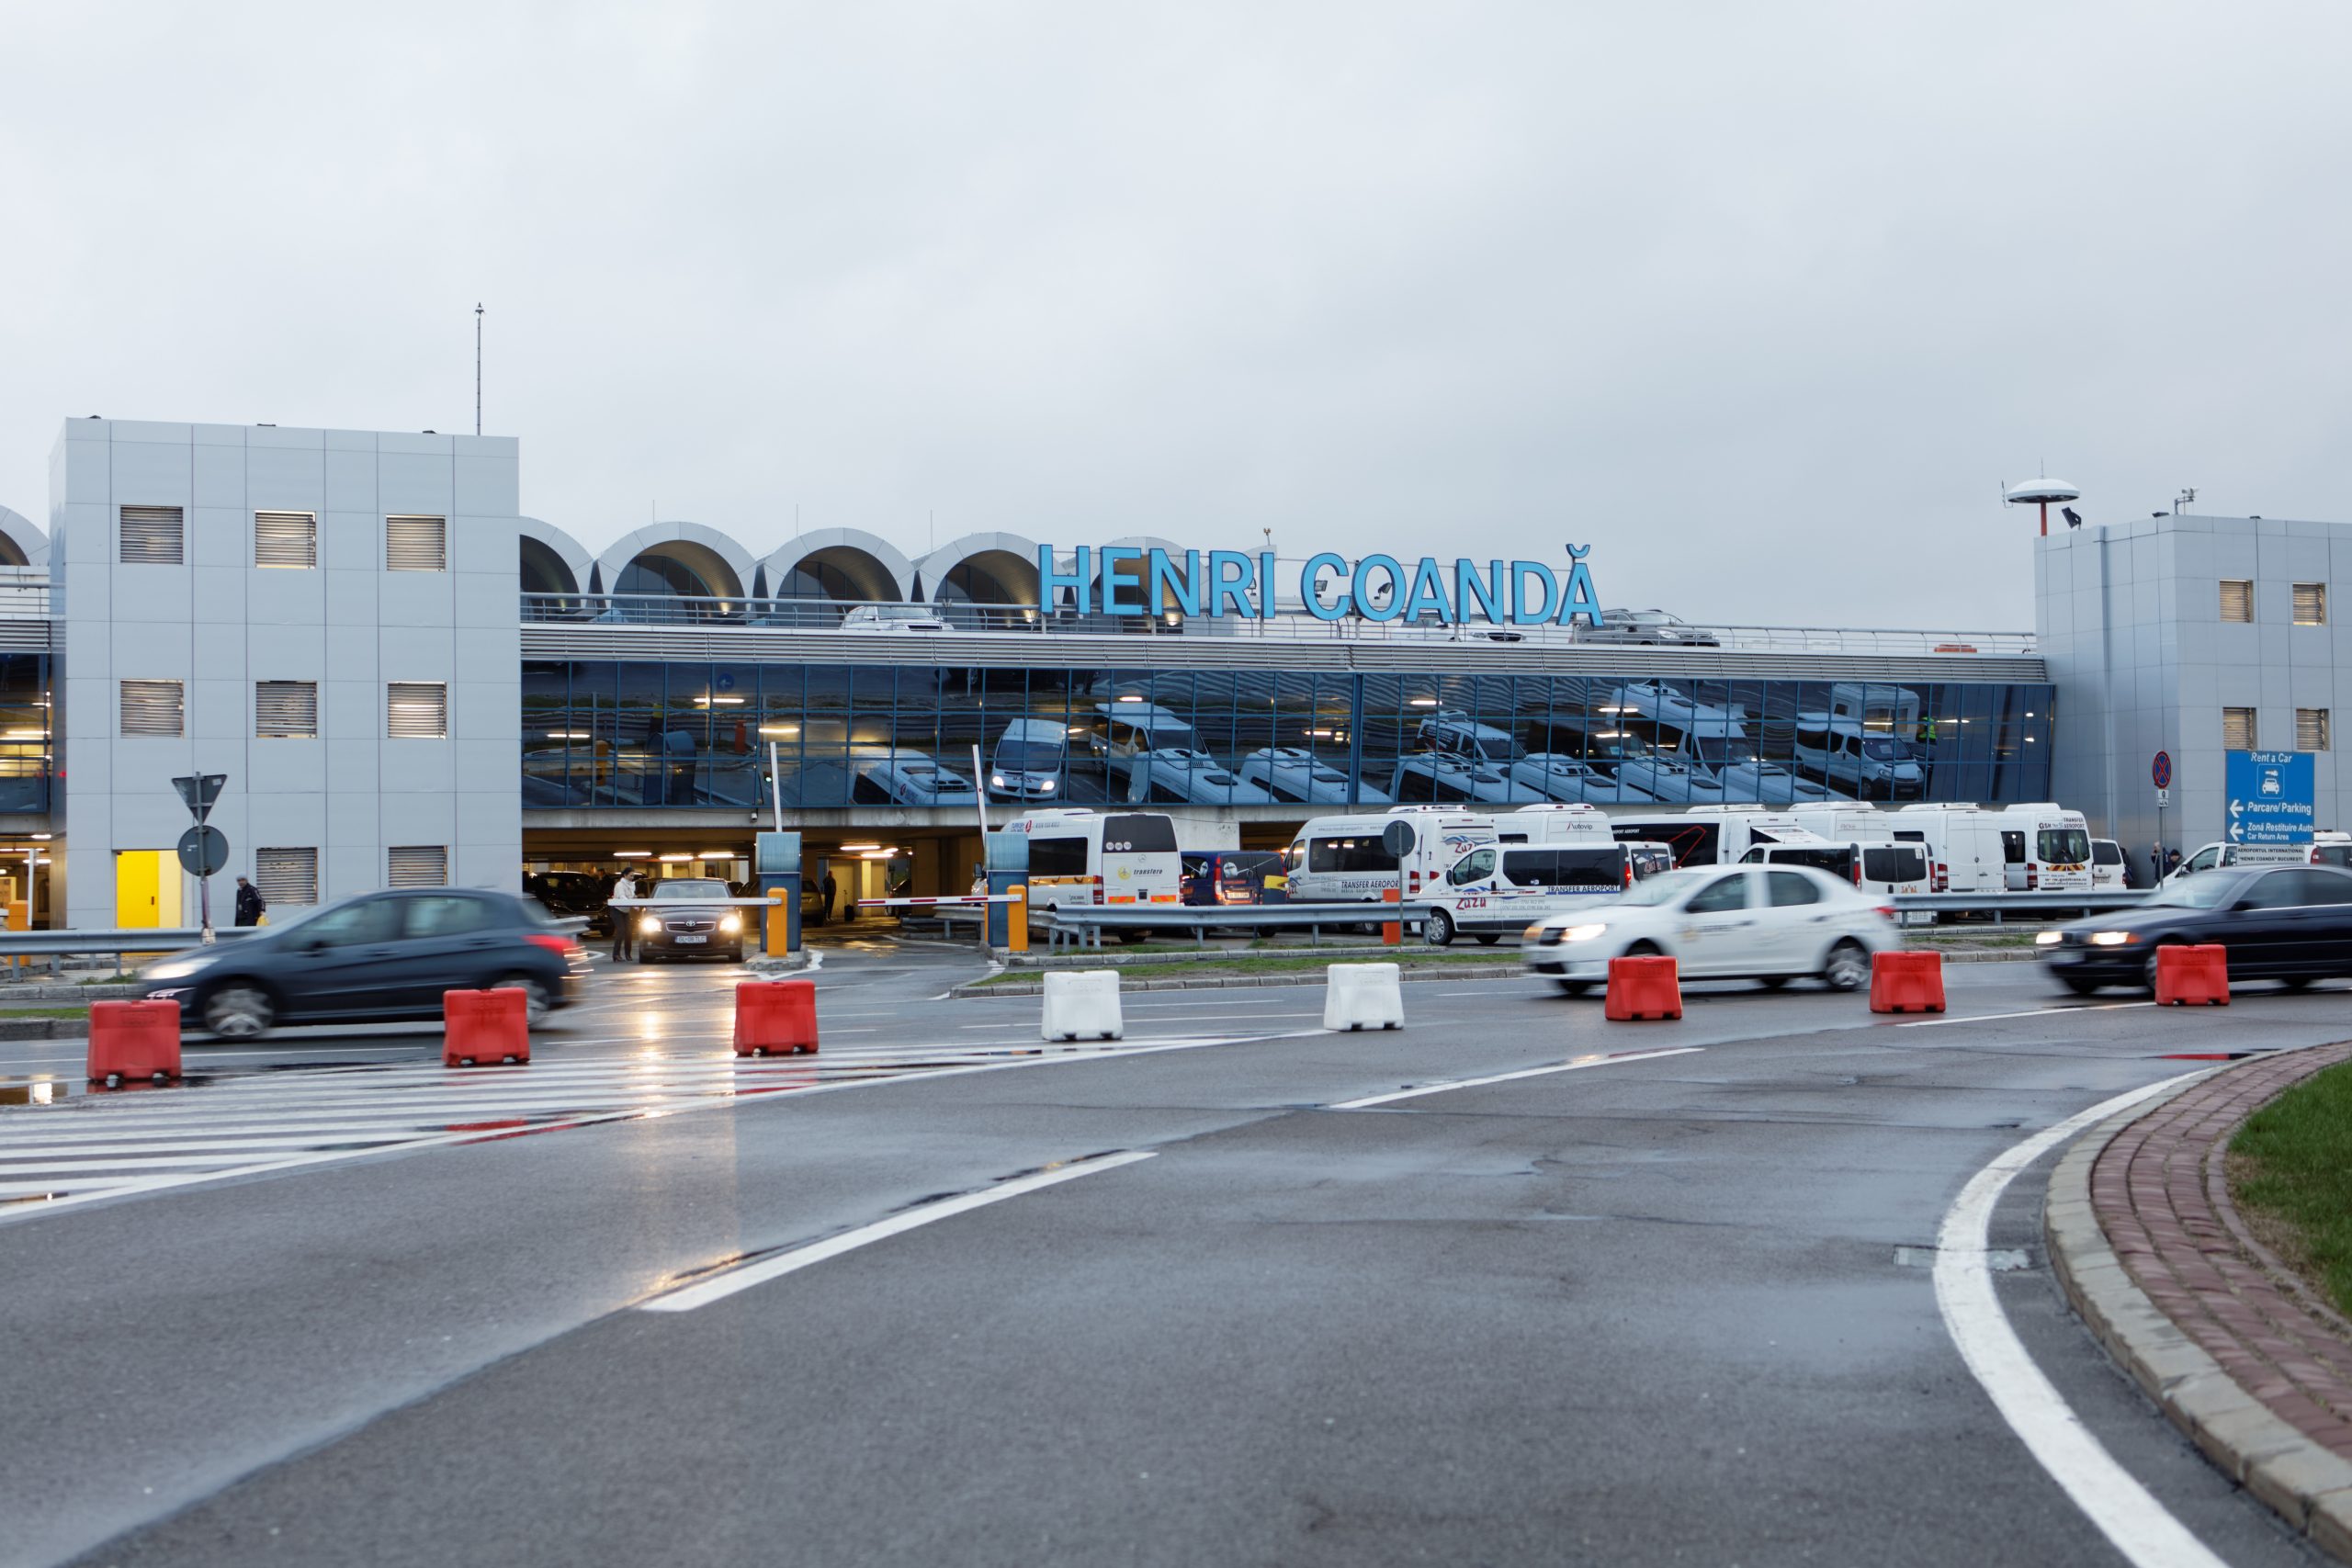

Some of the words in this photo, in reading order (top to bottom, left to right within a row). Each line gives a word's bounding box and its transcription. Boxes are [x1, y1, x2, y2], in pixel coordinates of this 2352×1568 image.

[1038, 544, 1275, 619] HENRI
[1300, 543, 1605, 627] COANDĂ
[2251, 751, 2269, 762] Rent
[2278, 752, 2292, 763] Car
[2281, 803, 2312, 816] Parking
[2265, 822, 2297, 832] Restituire
[2298, 823, 2314, 832] Auto
[2247, 832, 2256, 840] Car
[2257, 832, 2275, 840] Return
[1341, 881, 1370, 889] TRANSFER
[1370, 879, 1399, 888] AEROPOR
[1547, 886, 1580, 894] TRANSFER
[1581, 885, 1619, 893] AEROPORT
